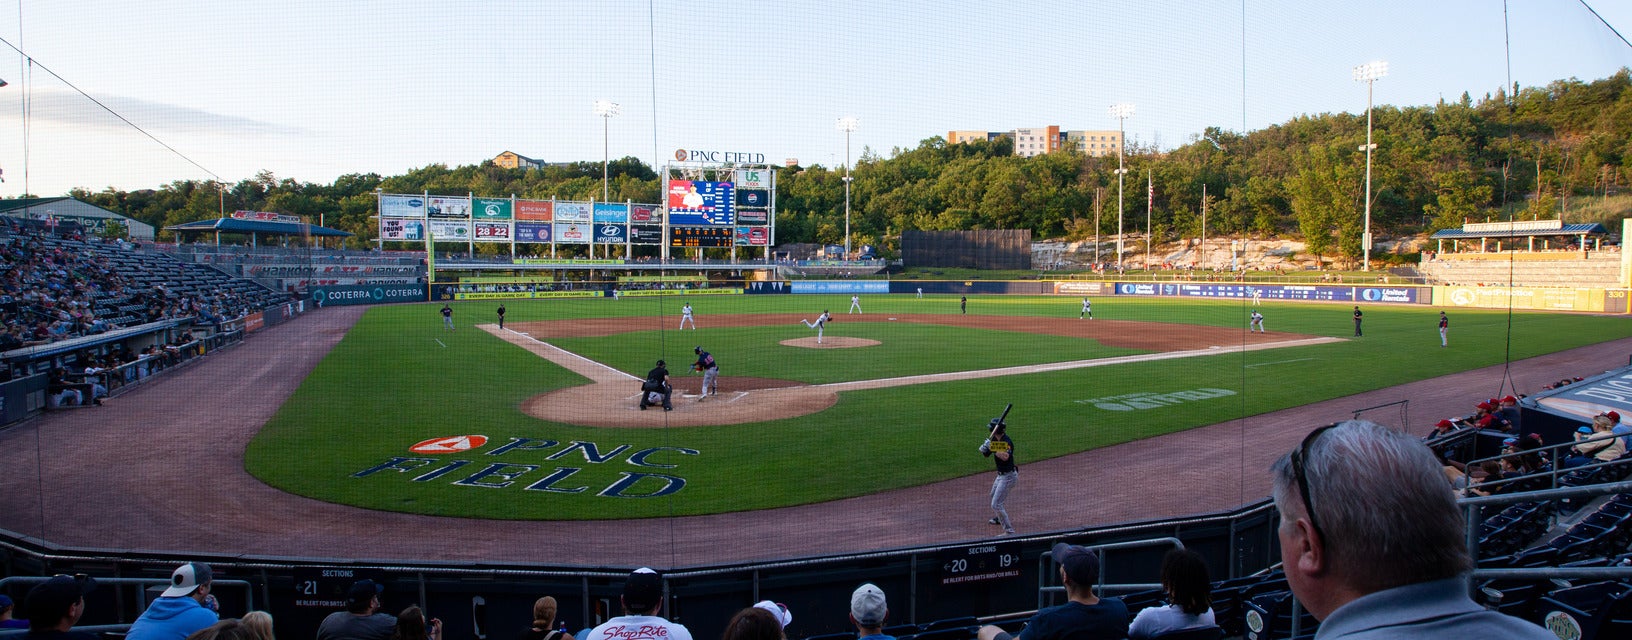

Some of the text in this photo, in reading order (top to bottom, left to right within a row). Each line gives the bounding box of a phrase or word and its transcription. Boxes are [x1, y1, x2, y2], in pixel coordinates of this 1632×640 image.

[690, 150, 765, 164] PNC FIELD
[595, 208, 627, 217] Geisinger
[478, 228, 491, 236] 28
[494, 228, 507, 236] 22
[328, 290, 371, 300] COTERRA
[385, 288, 424, 297] COTERRA
[1382, 288, 1408, 296] United
[1608, 290, 1624, 298] 330
[1382, 294, 1410, 302] Rentals
[485, 437, 700, 468] PNC
[349, 456, 687, 499] FIELD
[968, 545, 997, 555] SECTIONS
[951, 553, 1012, 573] 20 19
[322, 570, 354, 578] SECTIONS
[949, 576, 964, 584] ALERT
[304, 580, 317, 595] 21
[603, 625, 668, 640] ShopRite
